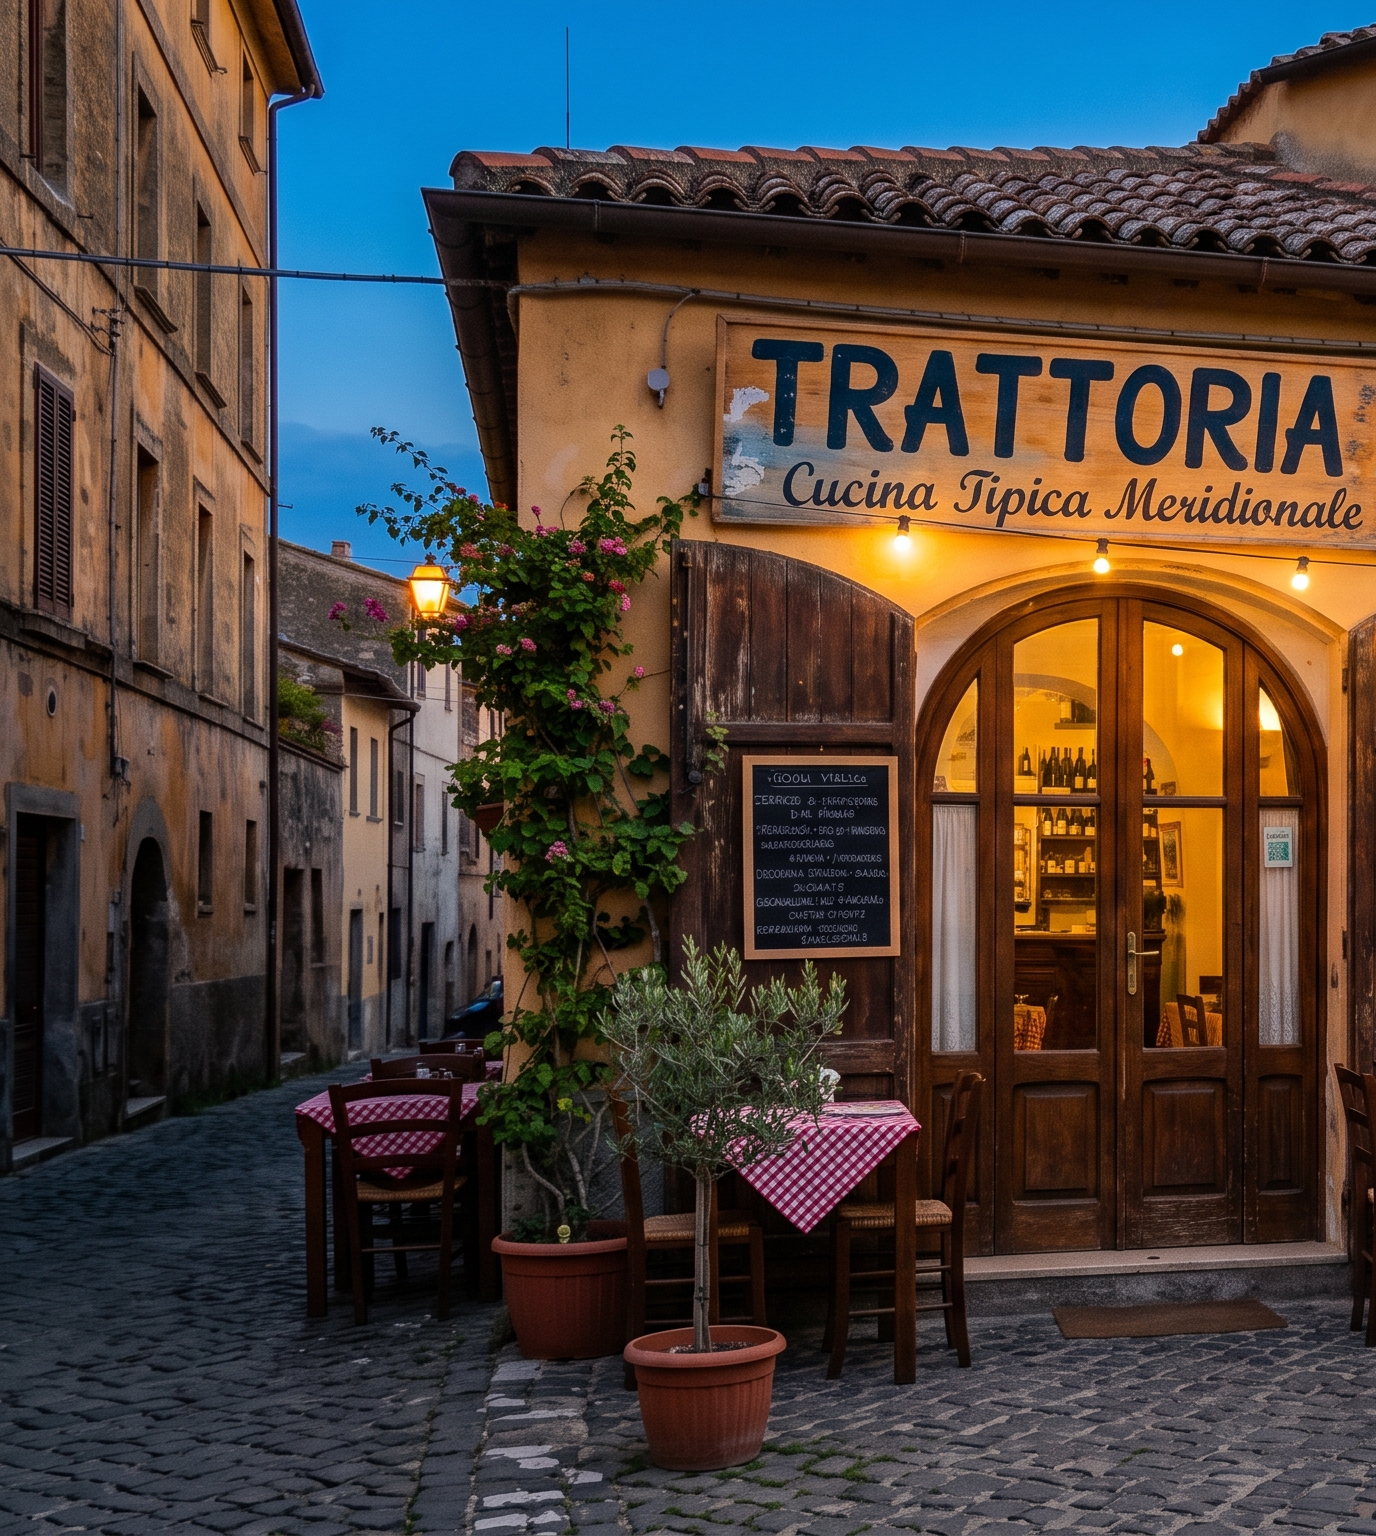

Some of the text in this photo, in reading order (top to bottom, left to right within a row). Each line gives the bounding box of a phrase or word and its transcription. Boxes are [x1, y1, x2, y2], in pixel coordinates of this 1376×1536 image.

[751, 338, 1343, 478] TRATTORIA
[782, 461, 1363, 531] Cucina Tipica Meridionale
